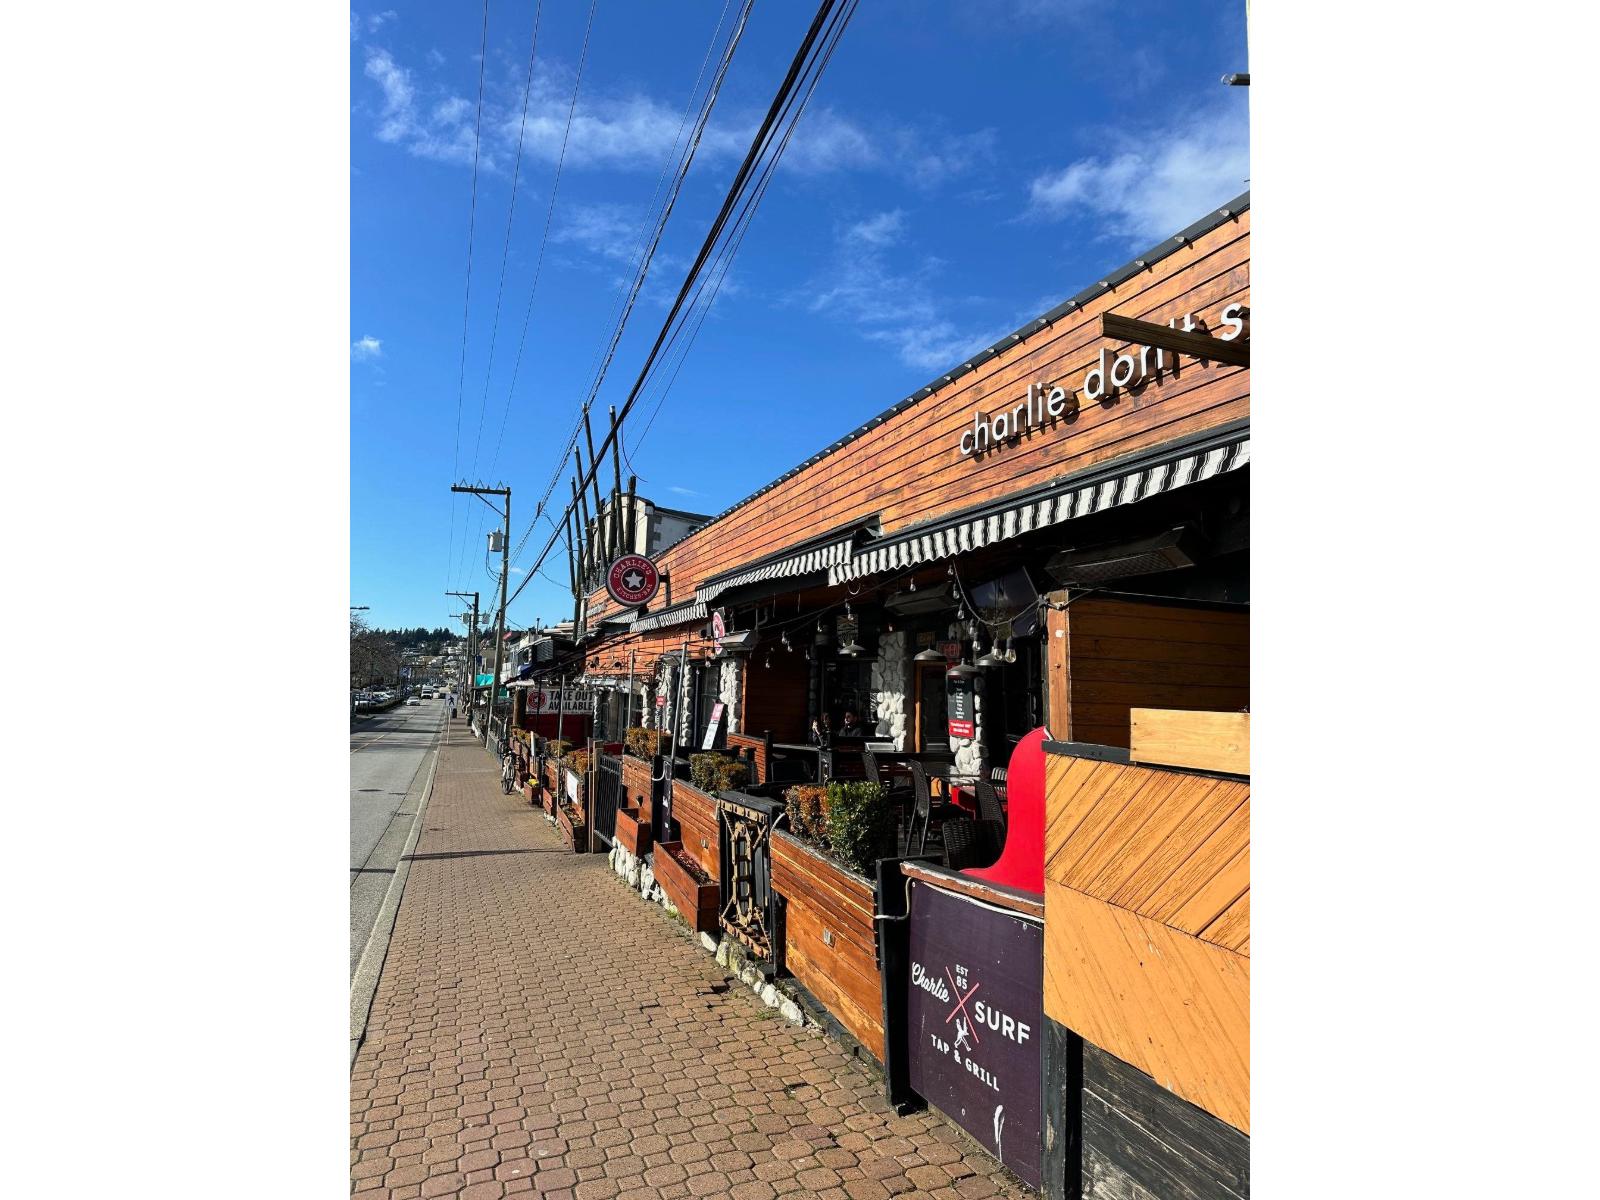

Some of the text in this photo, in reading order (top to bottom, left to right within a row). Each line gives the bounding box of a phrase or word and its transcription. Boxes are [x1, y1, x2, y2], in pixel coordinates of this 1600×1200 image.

[960, 382, 1066, 455] charlie
[549, 690, 573, 701] TAKE
[575, 690, 594, 701] OUT
[548, 701, 593, 710] AVILABLE
[955, 964, 969, 977] EST
[956, 976, 968, 990] 85
[911, 961, 1031, 1045] Charlie SURF
[930, 1034, 1000, 1092] TAP & GRILL
